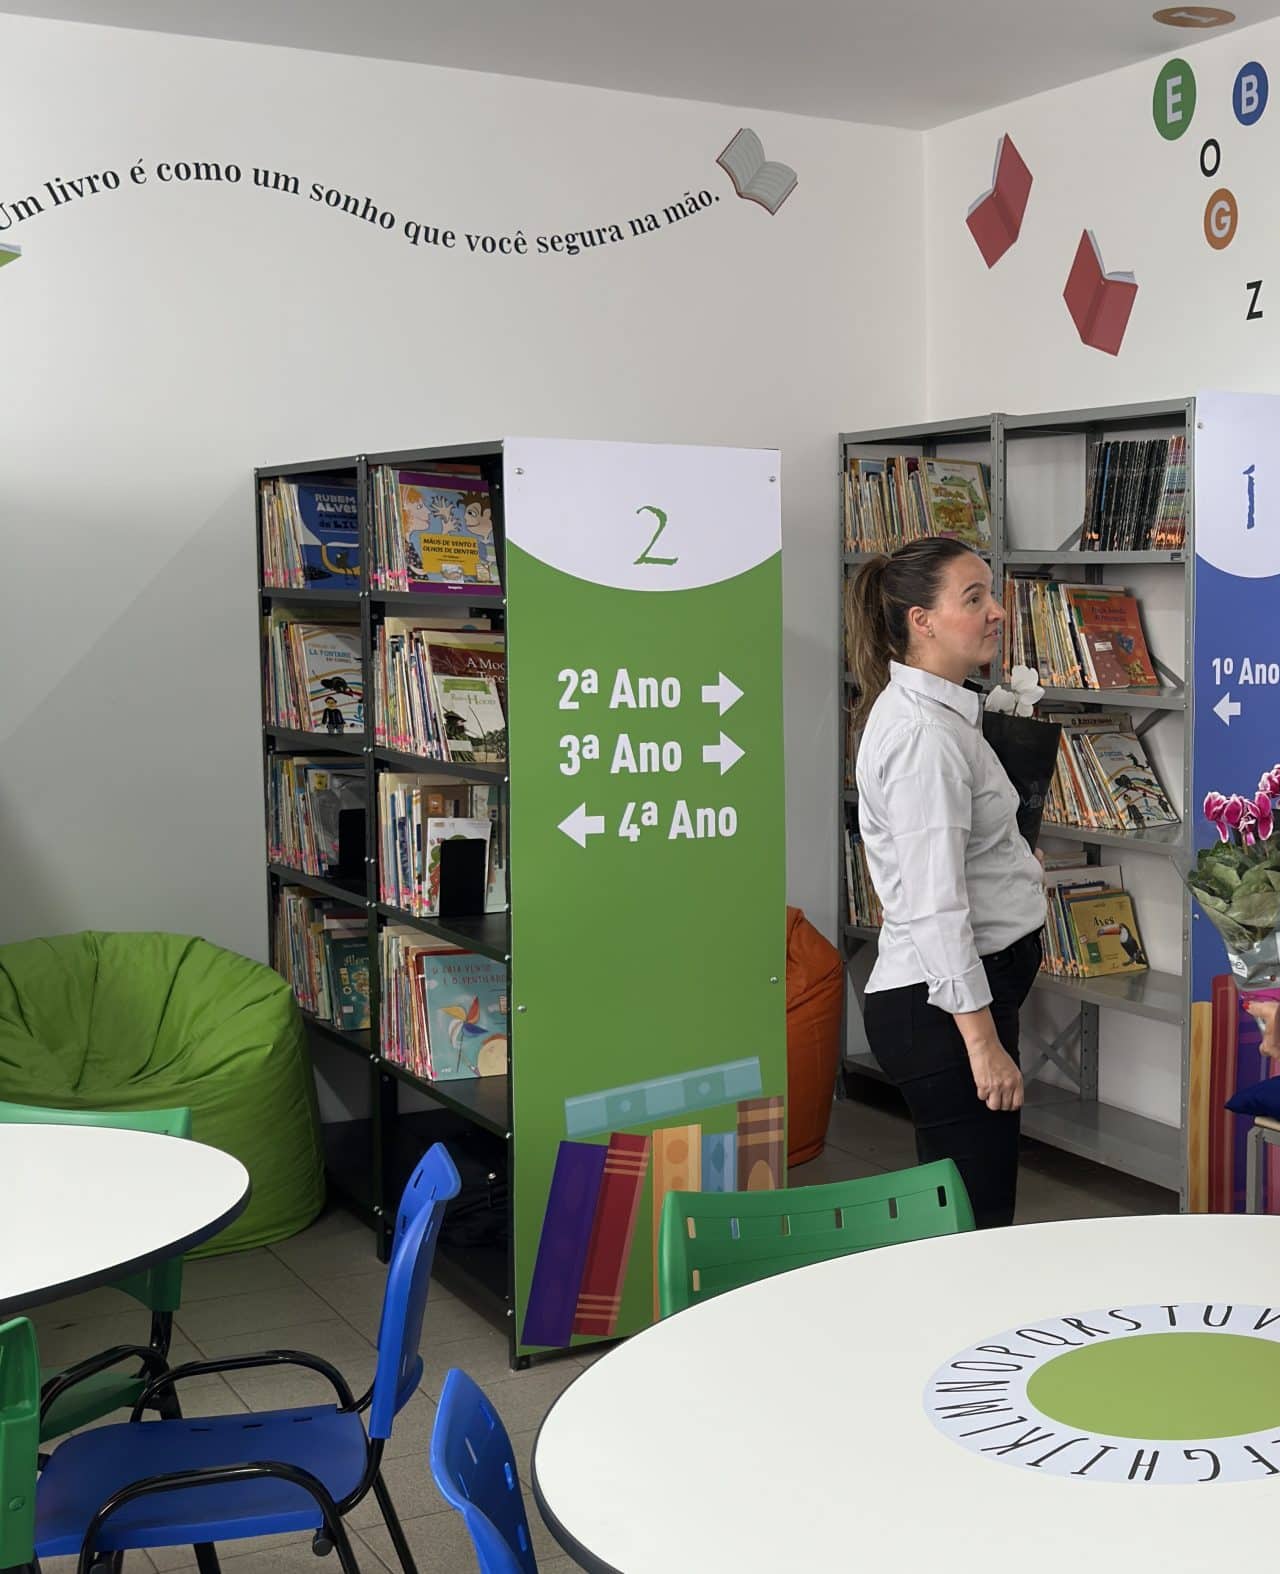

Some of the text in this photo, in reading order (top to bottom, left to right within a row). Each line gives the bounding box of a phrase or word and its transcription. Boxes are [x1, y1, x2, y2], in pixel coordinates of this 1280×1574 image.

[1166, 75, 1183, 124] E
[1241, 74, 1259, 115] B
[1199, 138, 1221, 178] O
[44, 170, 120, 206] livro
[130, 158, 147, 185] é
[157, 163, 242, 183] como
[252, 168, 300, 195] um
[309, 183, 396, 230] sonho
[404, 220, 456, 248] que
[465, 231, 528, 255] você
[537, 223, 625, 256] segura
[628, 215, 661, 237] na
[663, 191, 720, 225] mão.
[1210, 200, 1231, 238] G
[1246, 279, 1264, 321] Z
[1242, 464, 1256, 530] 1
[633, 505, 679, 566] 2
[557, 667, 682, 710] 2ª Ano
[1211, 657, 1280, 685] 1º Ano
[559, 733, 683, 776] 3ª Ano
[618, 800, 738, 843] 4ª Ano
